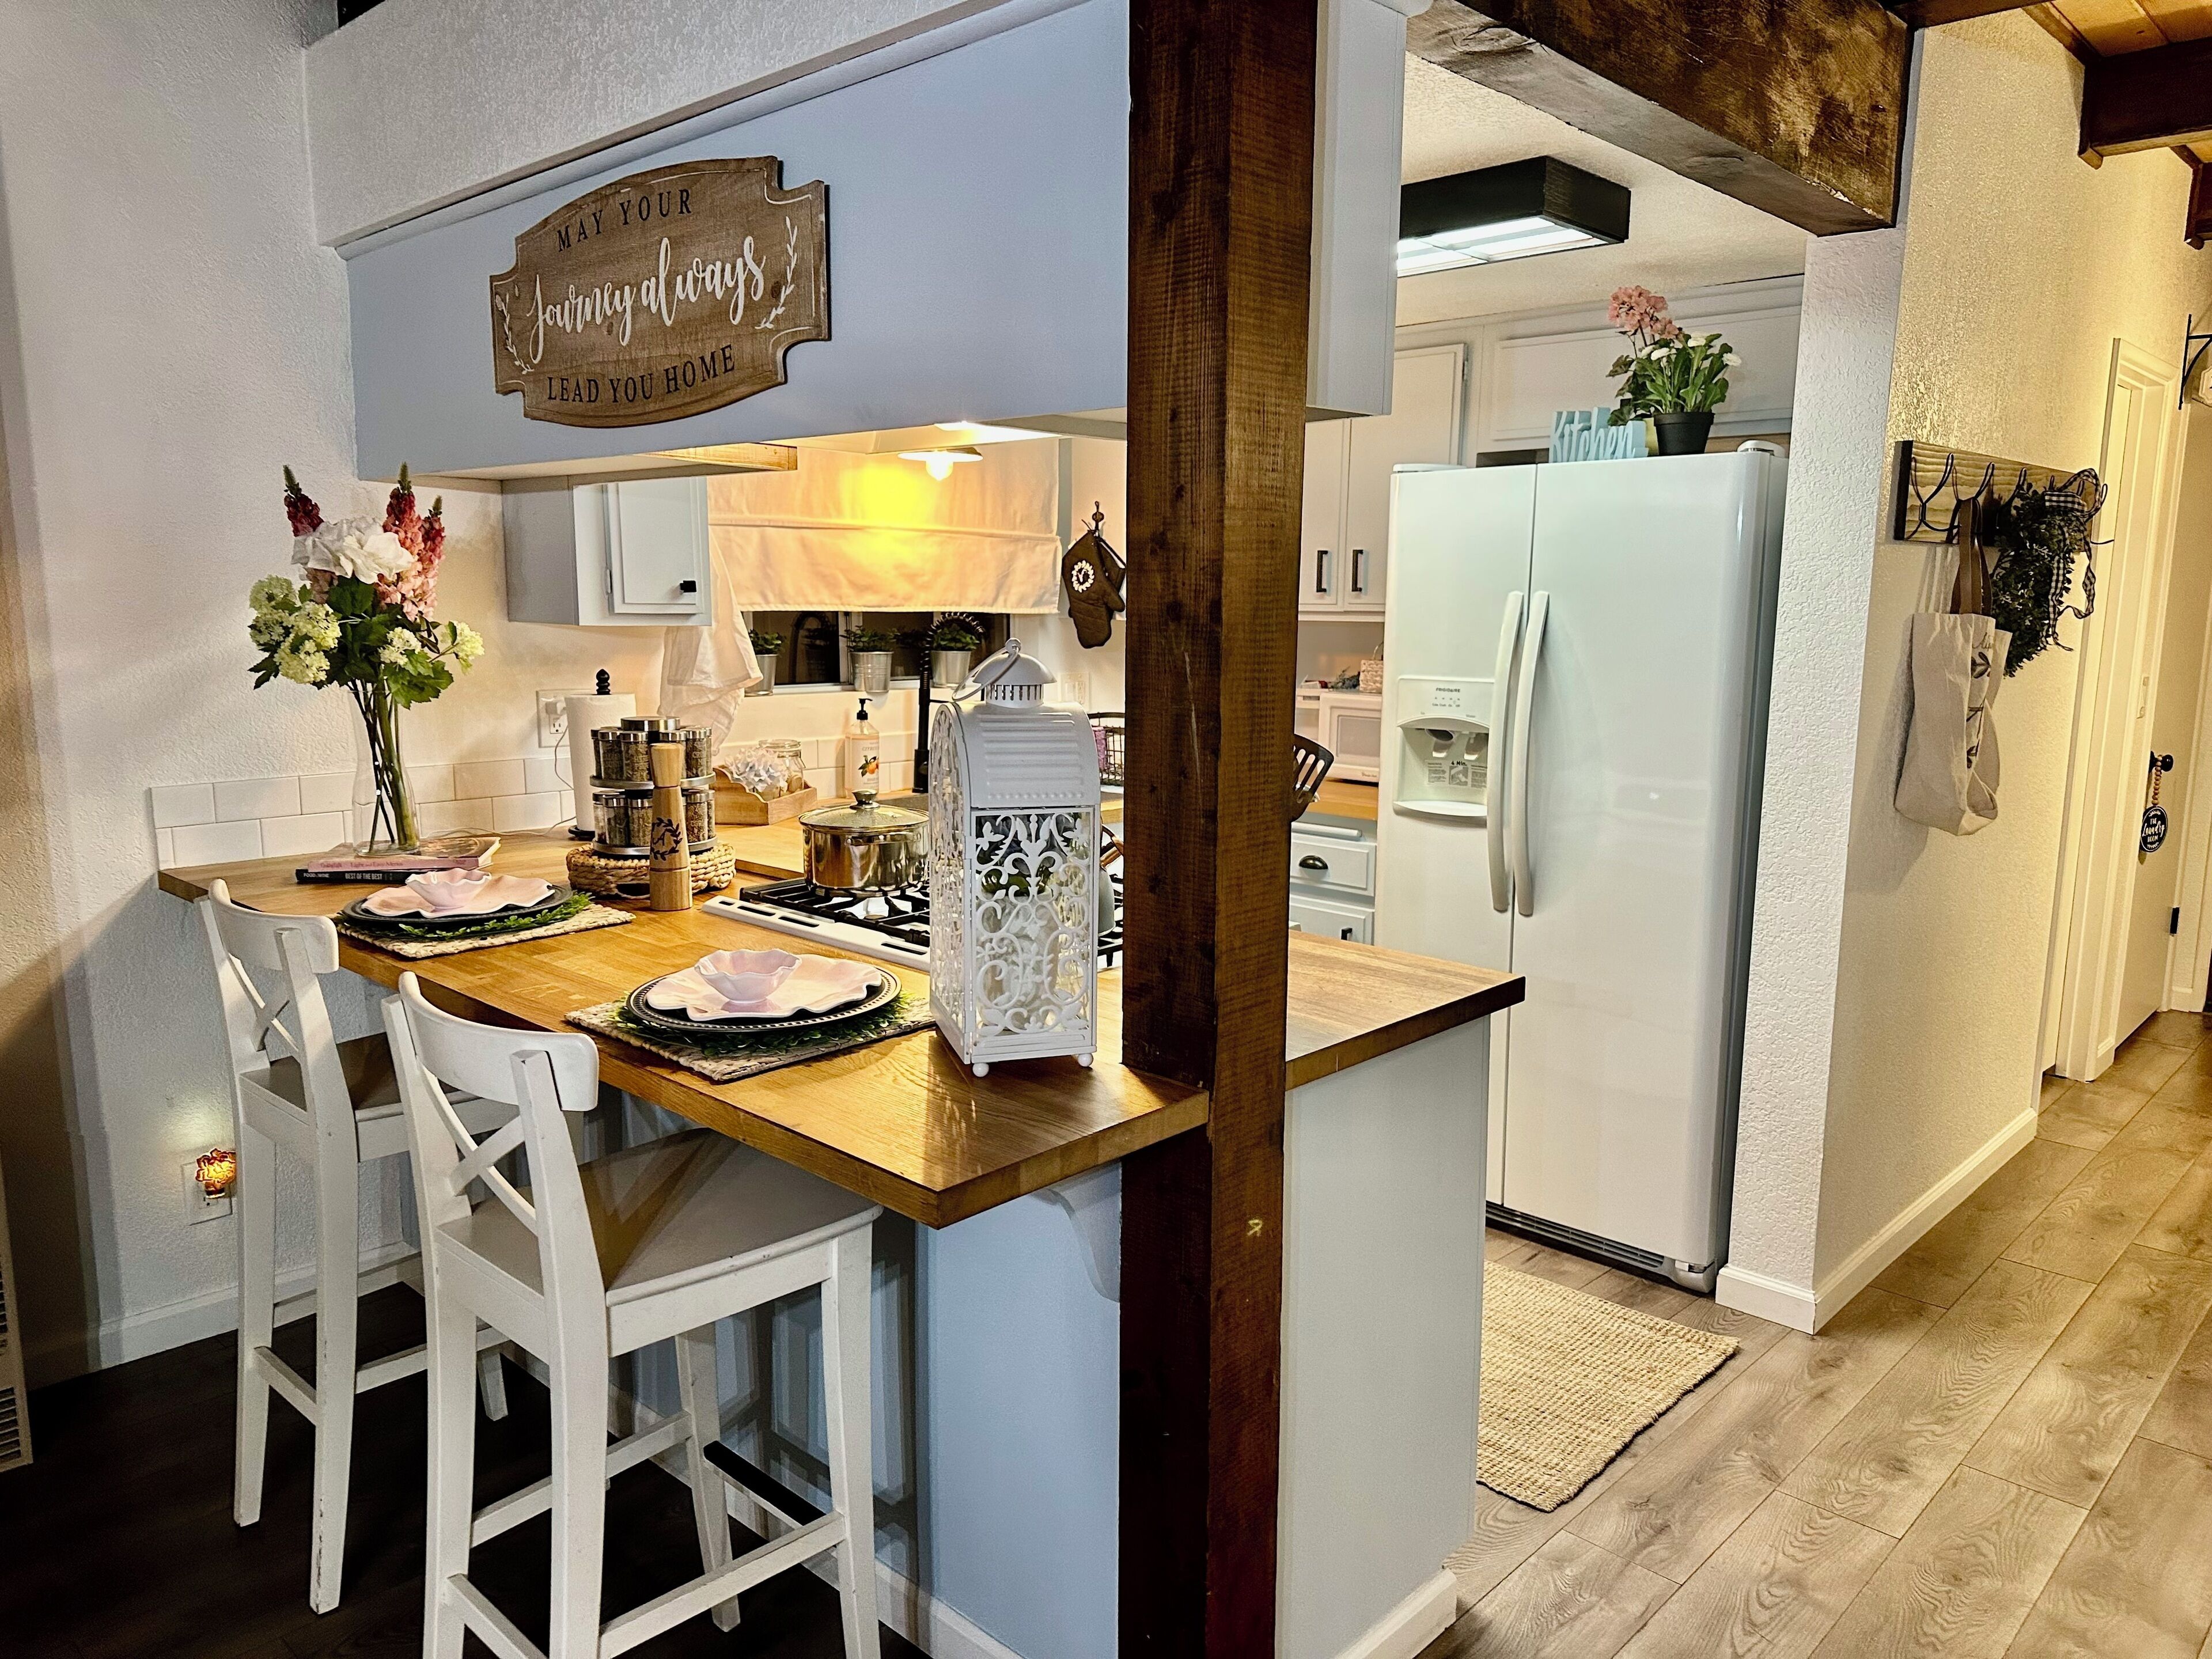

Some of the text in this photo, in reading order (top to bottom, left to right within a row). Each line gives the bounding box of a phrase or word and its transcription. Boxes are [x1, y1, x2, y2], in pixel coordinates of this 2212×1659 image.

[557, 188, 692, 252] MAY YOUR
[526, 237, 767, 365] Journey always
[547, 344, 736, 403] LEAD YOU HOME
[1549, 407, 1647, 463] Kitchen
